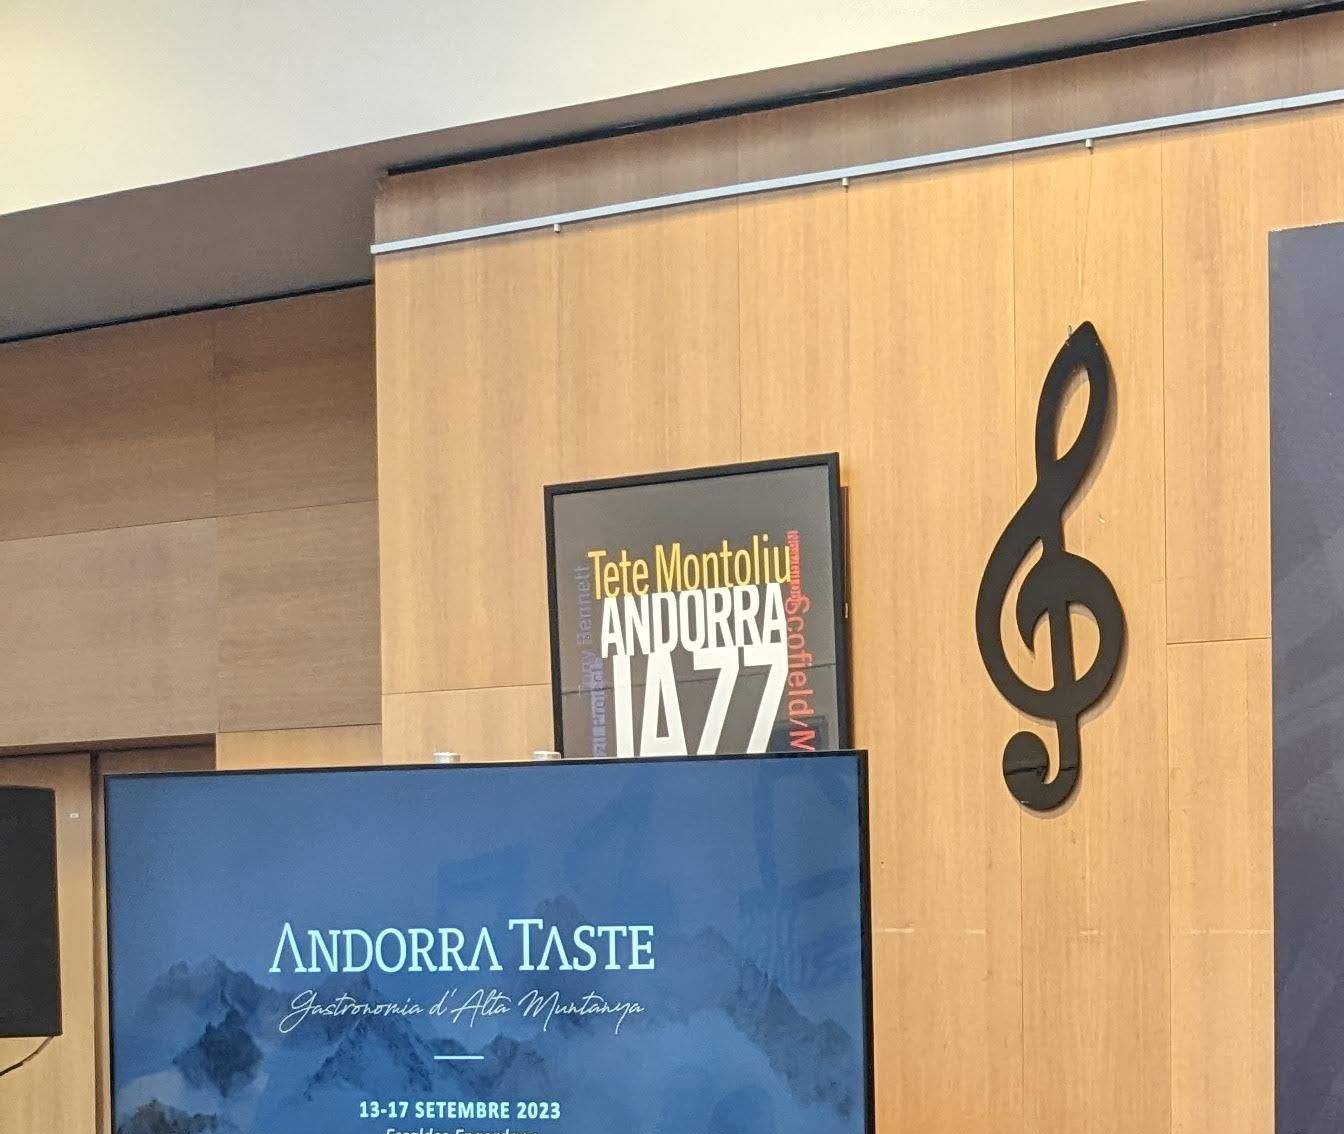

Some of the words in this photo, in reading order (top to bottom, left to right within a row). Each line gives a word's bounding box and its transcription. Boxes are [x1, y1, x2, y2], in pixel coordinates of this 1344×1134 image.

[587, 549, 650, 600] Tete
[654, 533, 792, 594] Montoliu
[601, 582, 789, 659] ANDORRA
[269, 922, 503, 974] ANDORRA
[508, 918, 656, 972] TASTE
[279, 990, 425, 1034] Gastronomia
[517, 988, 646, 1035] Muntanya
[359, 1101, 410, 1118] 13-17
[415, 1102, 511, 1119] SETEMBRE
[516, 1102, 562, 1119] 2023
